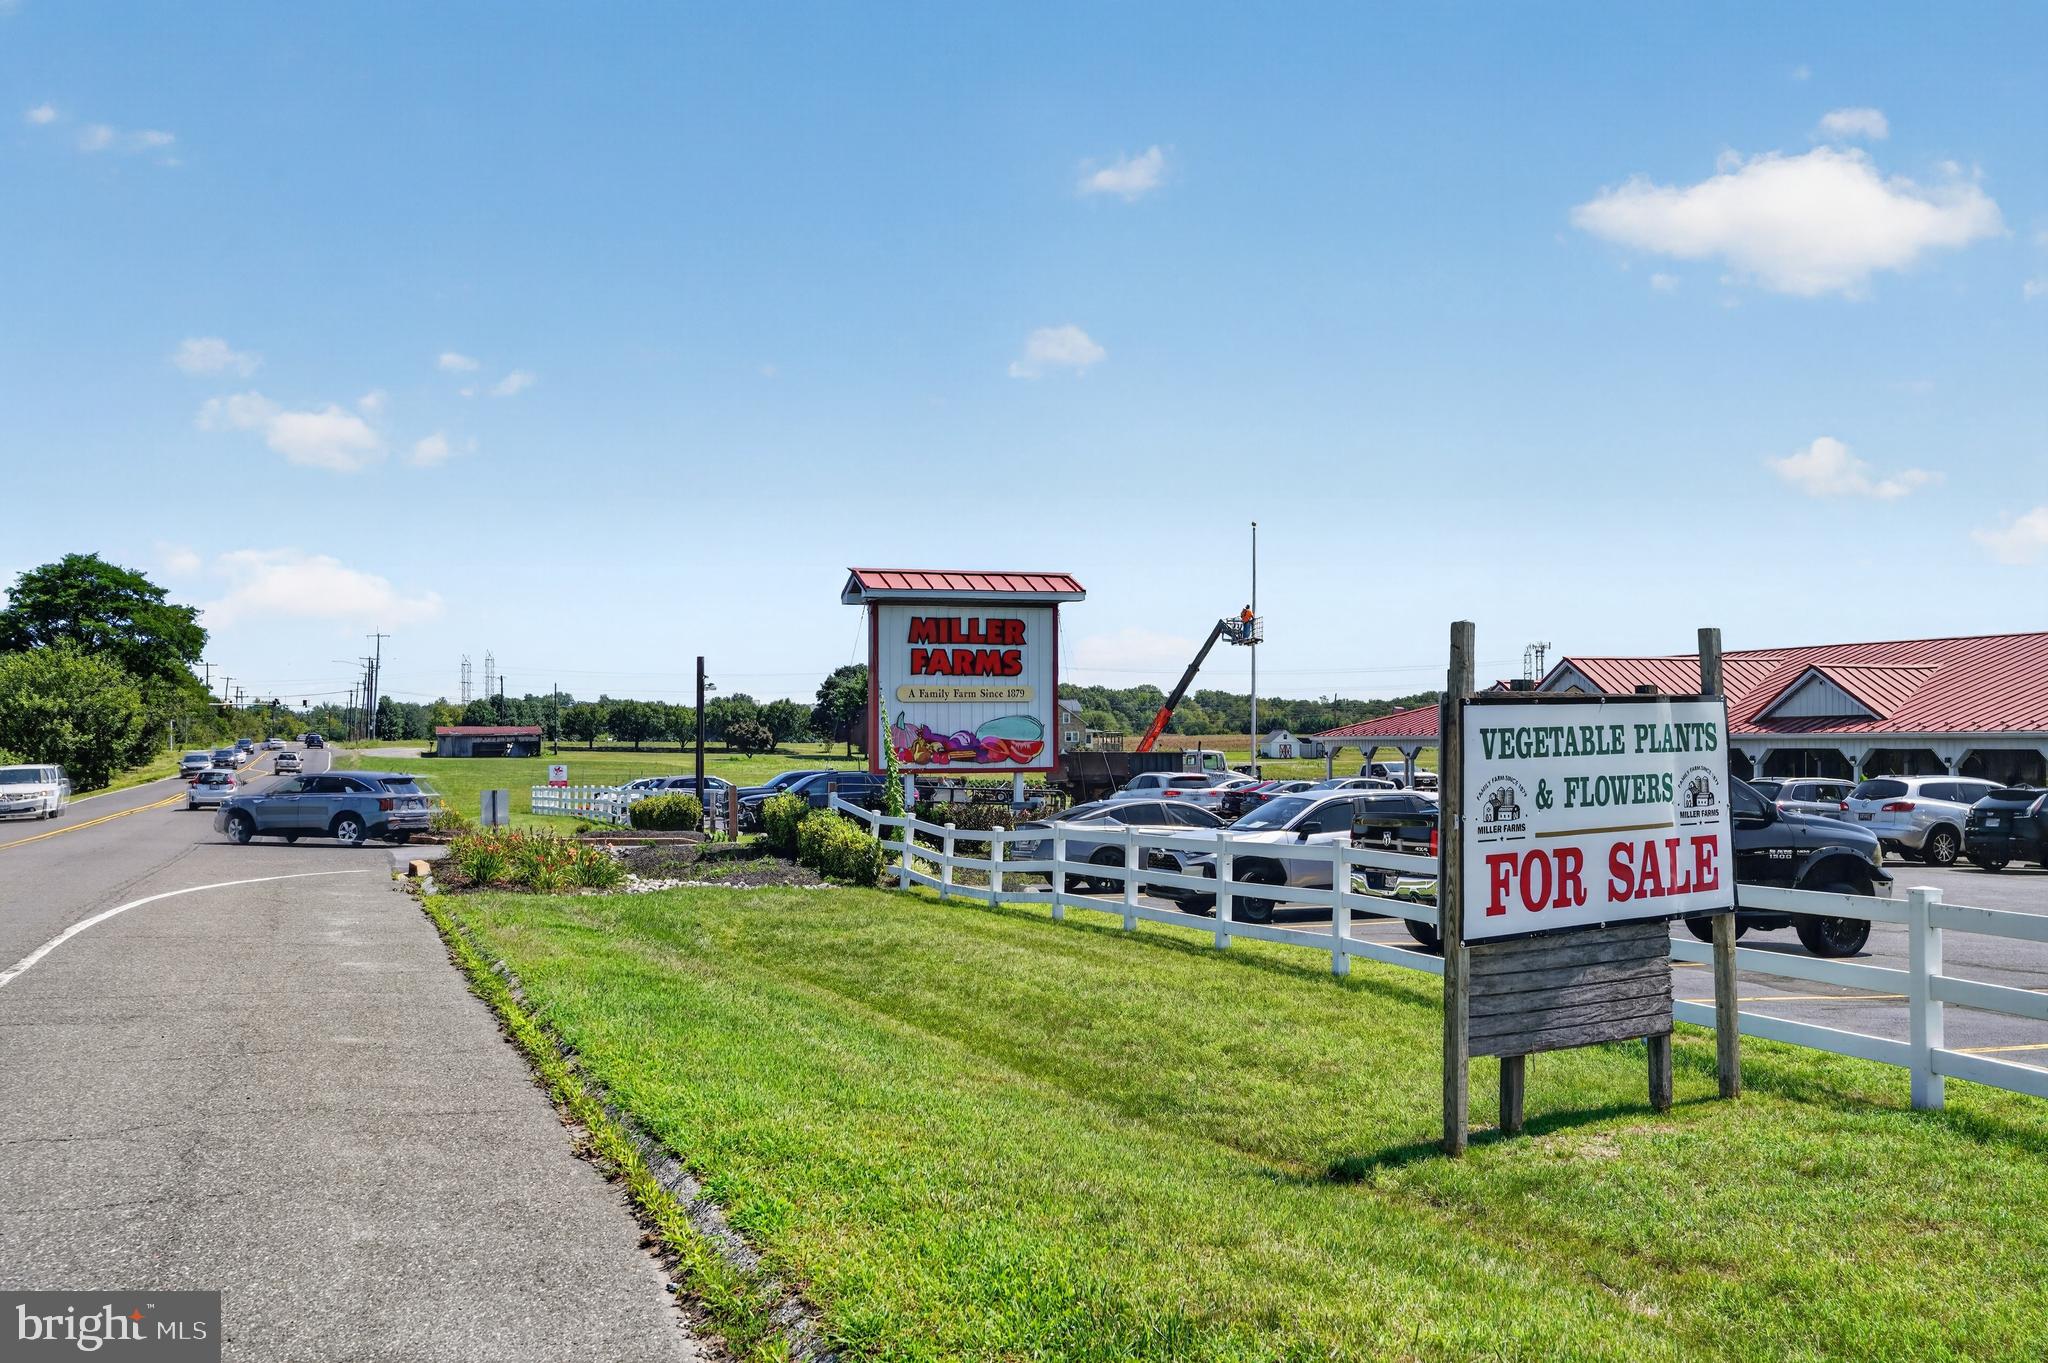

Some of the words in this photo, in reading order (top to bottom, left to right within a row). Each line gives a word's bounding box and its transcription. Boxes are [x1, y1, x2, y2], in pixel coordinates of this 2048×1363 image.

[908, 616, 1027, 645] MILLER
[911, 648, 1023, 677] FARMS
[908, 689, 915, 698] A
[919, 688, 950, 701] Family
[953, 689, 976, 698] Farm
[980, 689, 1003, 698] Since
[1007, 688, 1025, 698] 1879
[1480, 725, 1625, 760] VEGETABLE
[1634, 722, 1718, 753] PLANTS
[1535, 778, 1553, 810] &
[1564, 773, 1674, 808] FLOWERS
[1680, 810, 1700, 819] MILLER
[1701, 809, 1719, 817] FARMS
[1477, 825, 1502, 835] MILLER
[1503, 823, 1526, 833] FARMS
[1486, 847, 1587, 916] FOR
[1608, 834, 1719, 902] SALE
